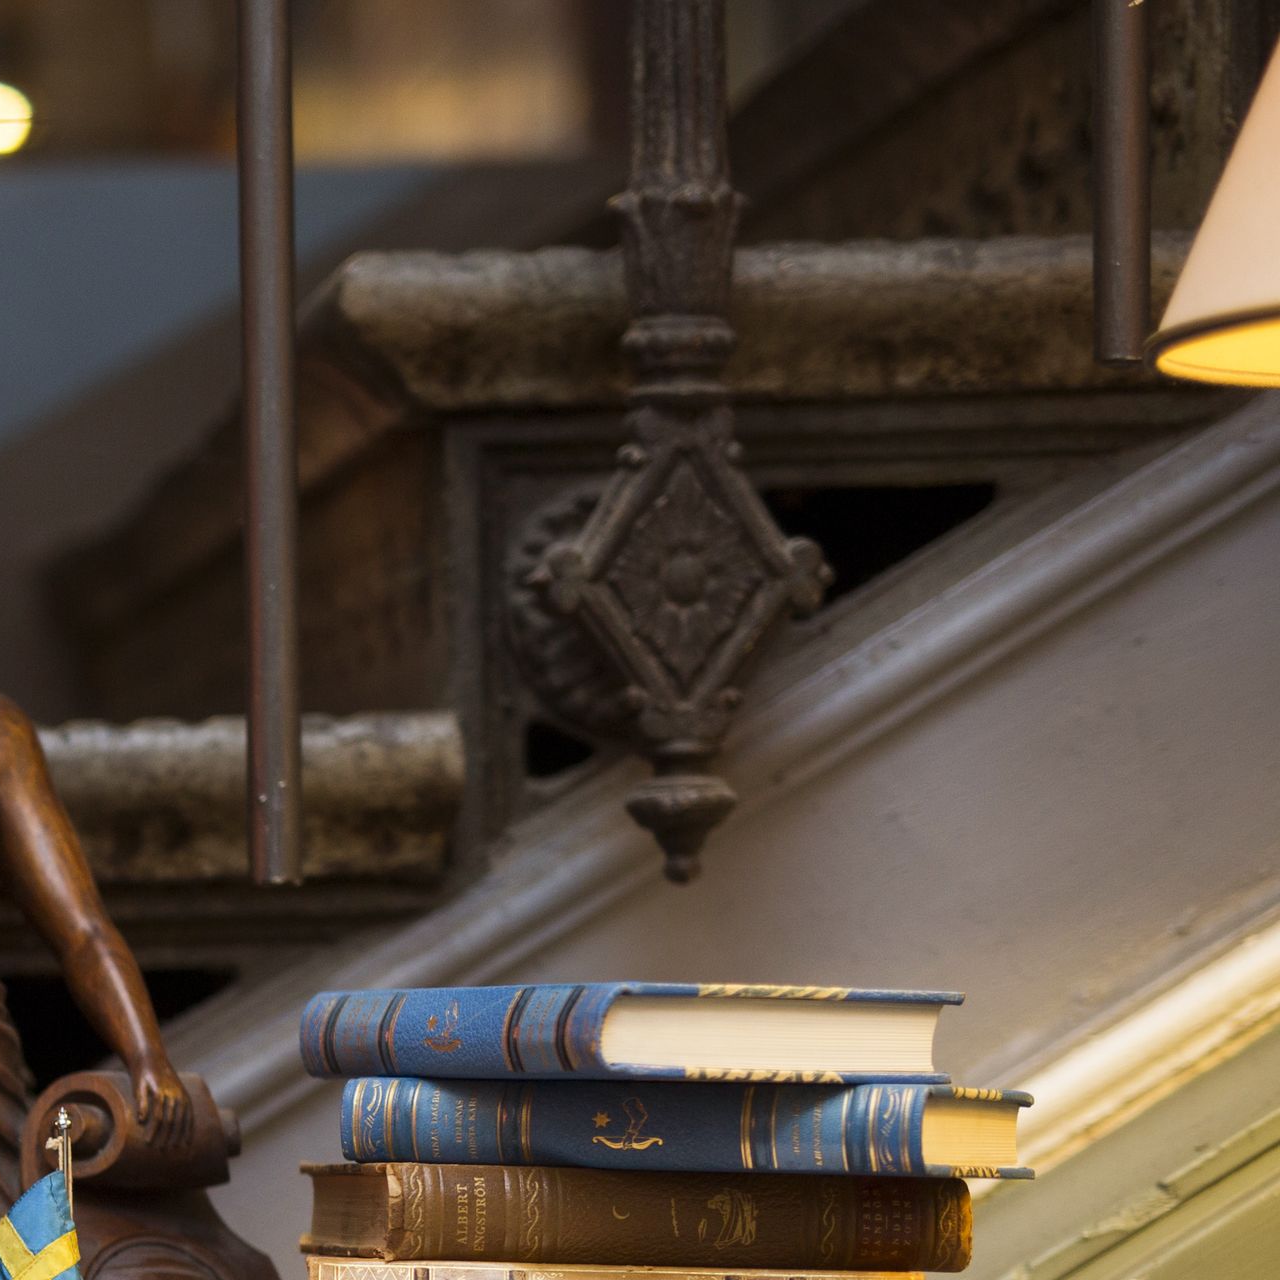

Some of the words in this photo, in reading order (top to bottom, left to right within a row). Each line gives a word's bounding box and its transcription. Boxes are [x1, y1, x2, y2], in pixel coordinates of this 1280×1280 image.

[432, 1089, 441, 1123] DAGBO
[456, 1183, 469, 1245] ALBERT
[473, 1176, 486, 1252] ENGSTRÖM
